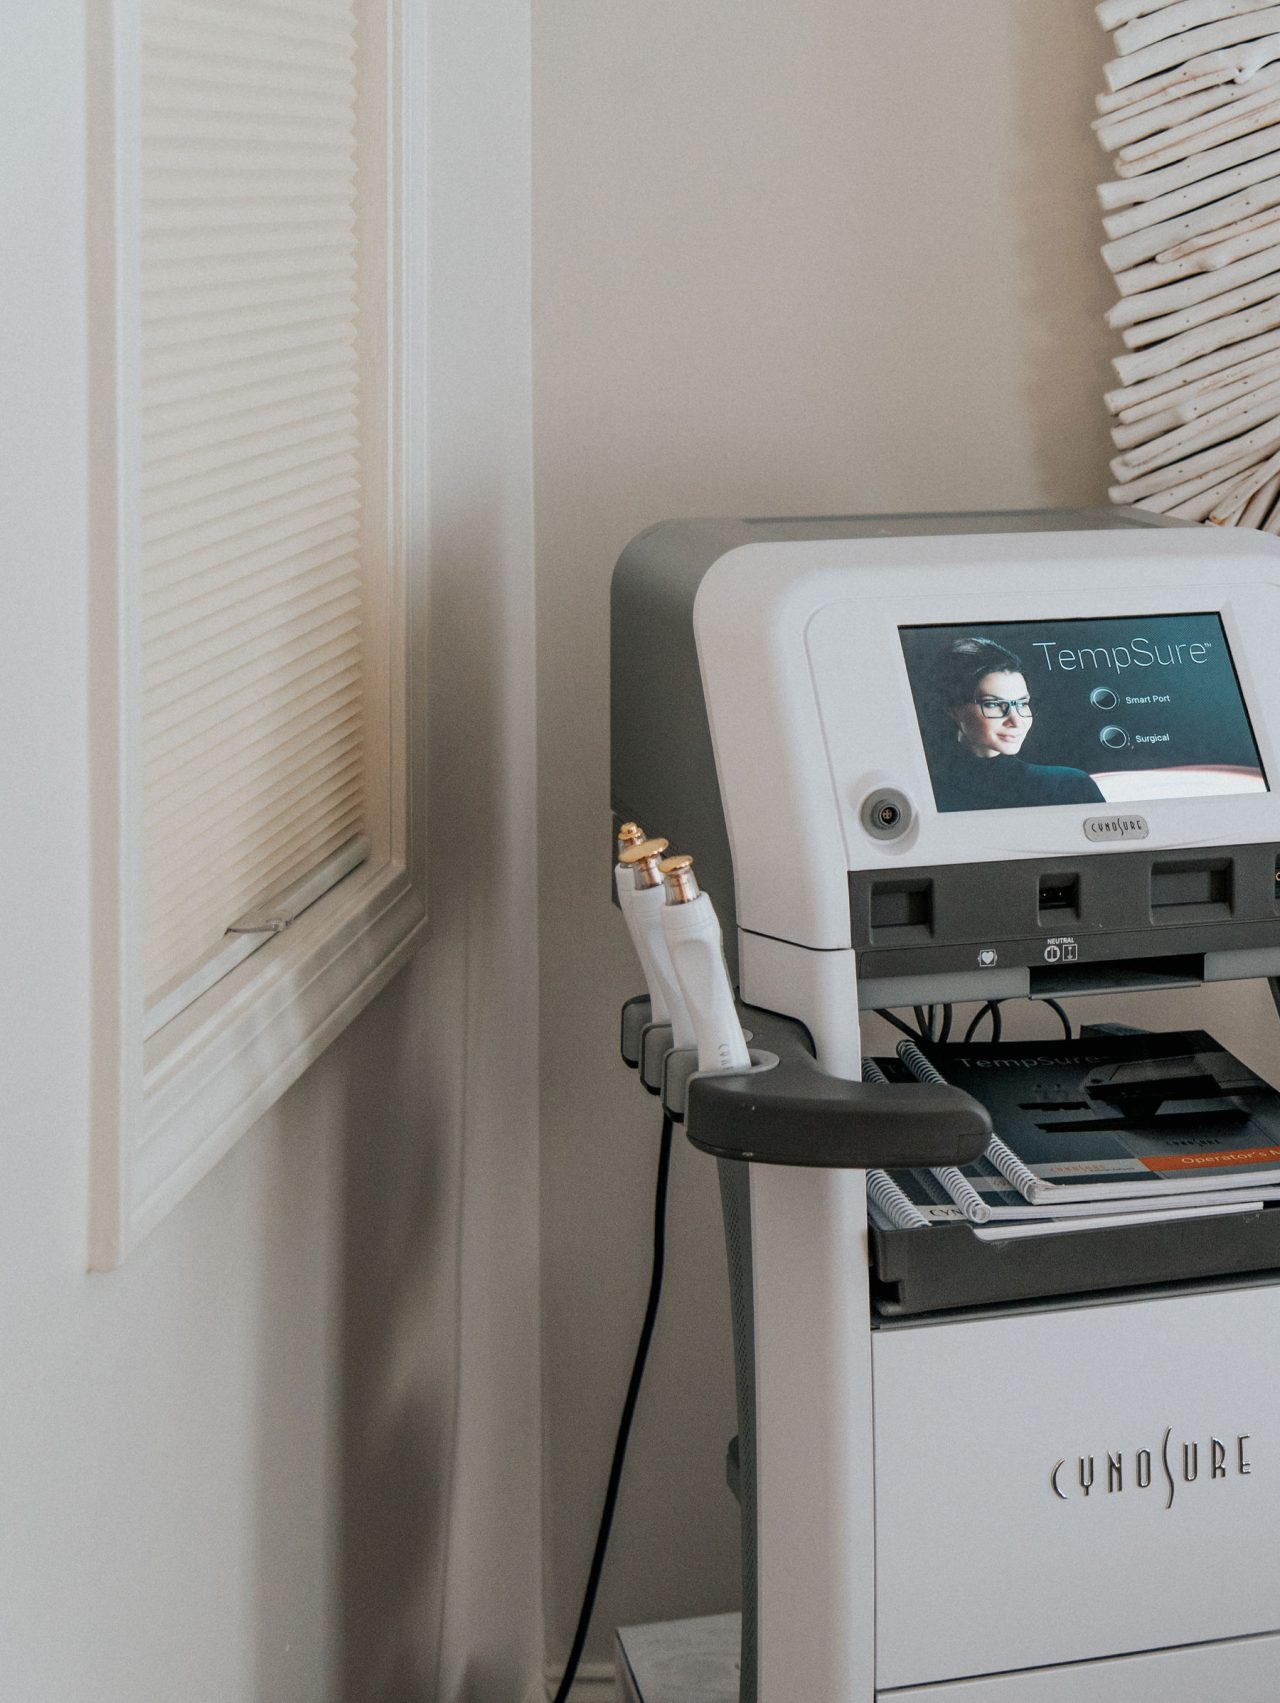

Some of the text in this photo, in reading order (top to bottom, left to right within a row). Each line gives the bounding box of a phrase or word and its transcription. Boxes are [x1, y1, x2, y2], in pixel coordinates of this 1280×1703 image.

[1125, 694, 1171, 705] Smart Port
[1135, 733, 1170, 745] Surgical
[1091, 817, 1142, 836] CYNOSURE
[1047, 936, 1075, 945] NEUTRAL
[1051, 1424, 1252, 1510] CYNOSURE
